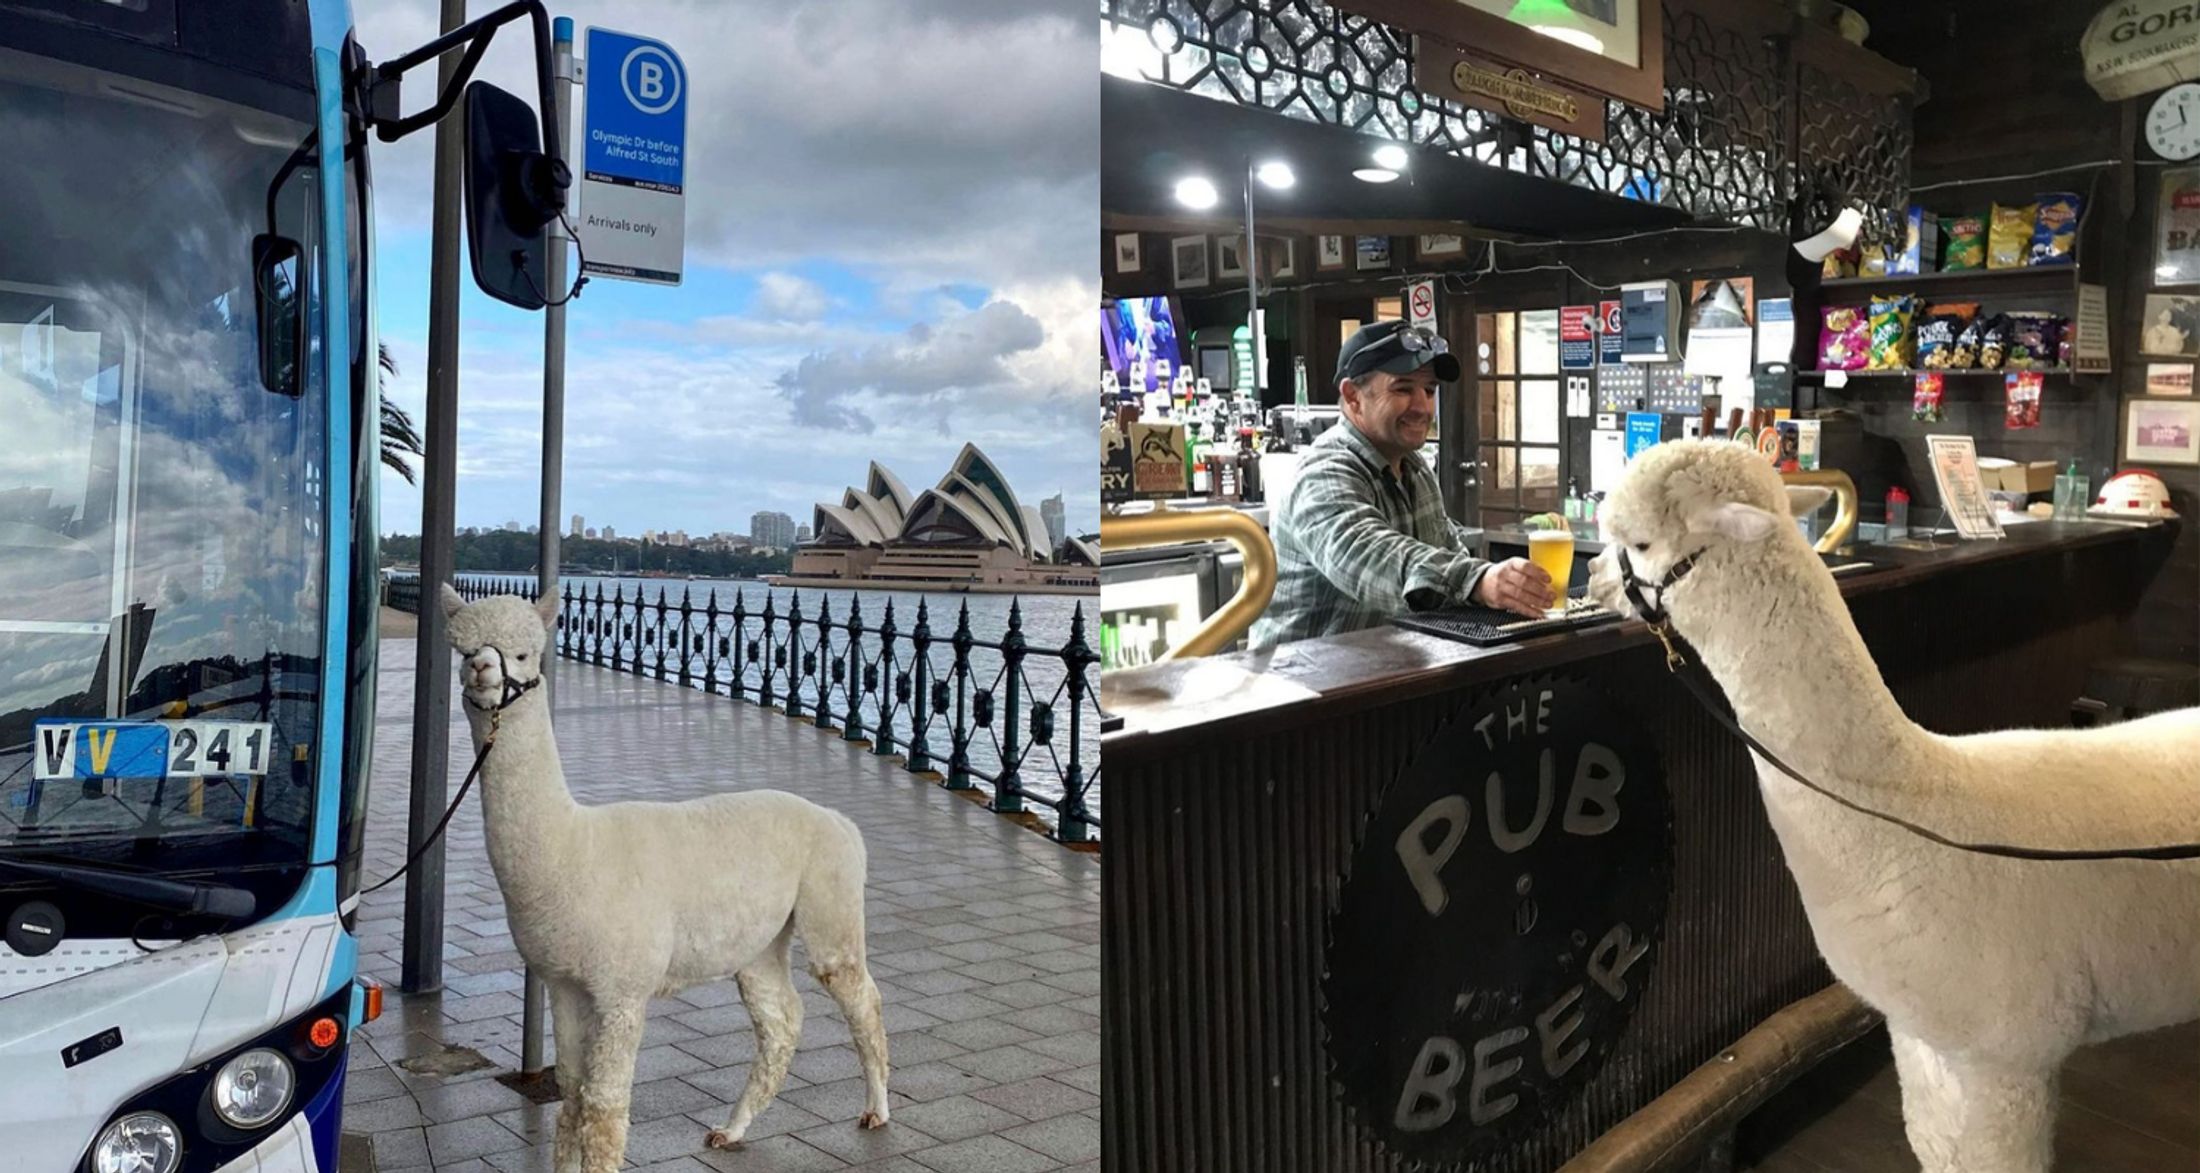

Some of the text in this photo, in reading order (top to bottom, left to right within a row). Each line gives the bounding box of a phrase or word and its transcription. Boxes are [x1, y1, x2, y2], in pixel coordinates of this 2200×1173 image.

[2110, 4, 2200, 42] GOR
[639, 61, 664, 100] B
[592, 129, 679, 154] Olympic Dr before
[606, 145, 679, 167] Alfred St South
[587, 214, 657, 237] Arrivals only
[1473, 689, 1553, 751] THE
[41, 727, 263, 776] V V 241
[1395, 741, 1626, 917] PUB
[1394, 922, 1650, 1133] BEER
